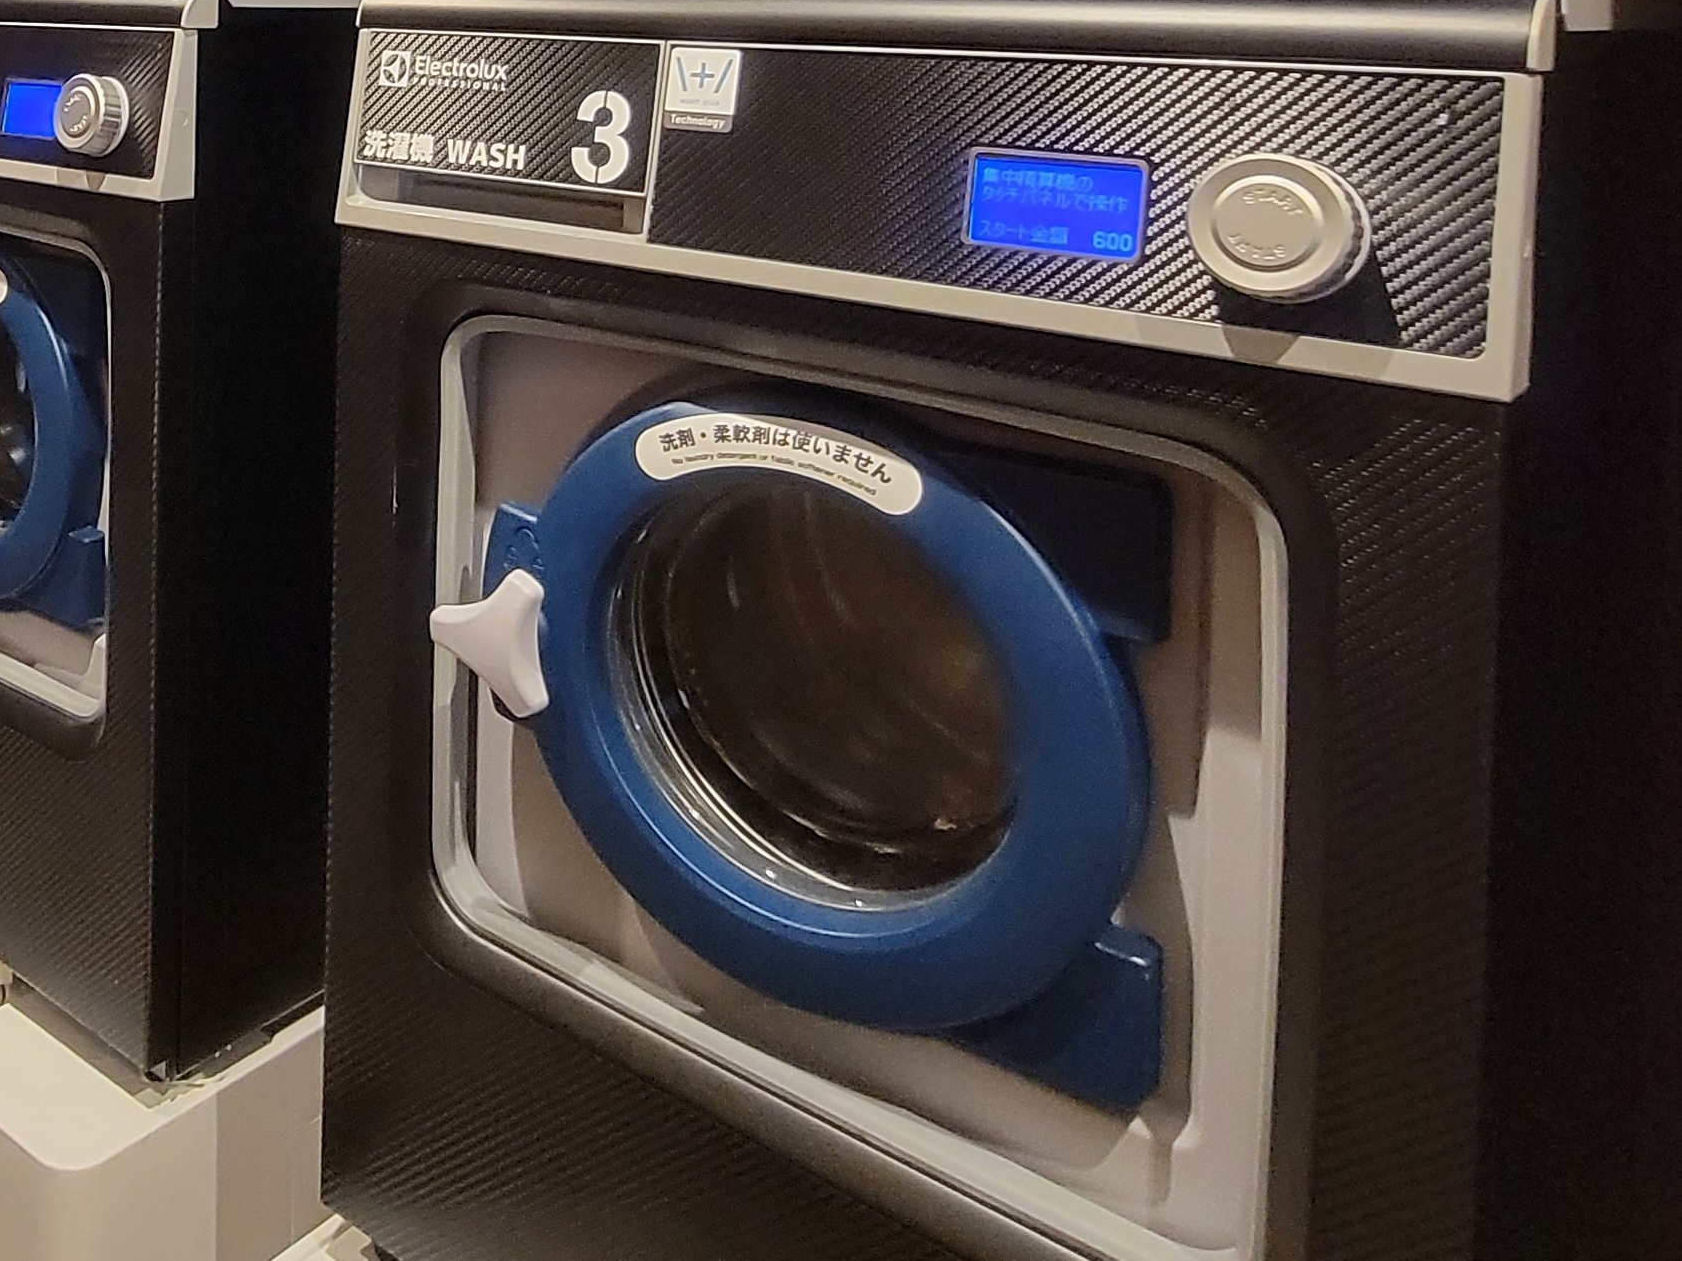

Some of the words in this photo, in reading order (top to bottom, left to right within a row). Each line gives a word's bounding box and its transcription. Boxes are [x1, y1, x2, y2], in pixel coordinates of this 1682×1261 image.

[414, 54, 509, 81] Electrolux
[670, 113, 726, 130] Technology
[570, 90, 632, 185] 3
[447, 138, 527, 171] WASH
[1092, 230, 1134, 252] 600
[658, 424, 892, 485] 洗剤・柔軟剤は使いません
